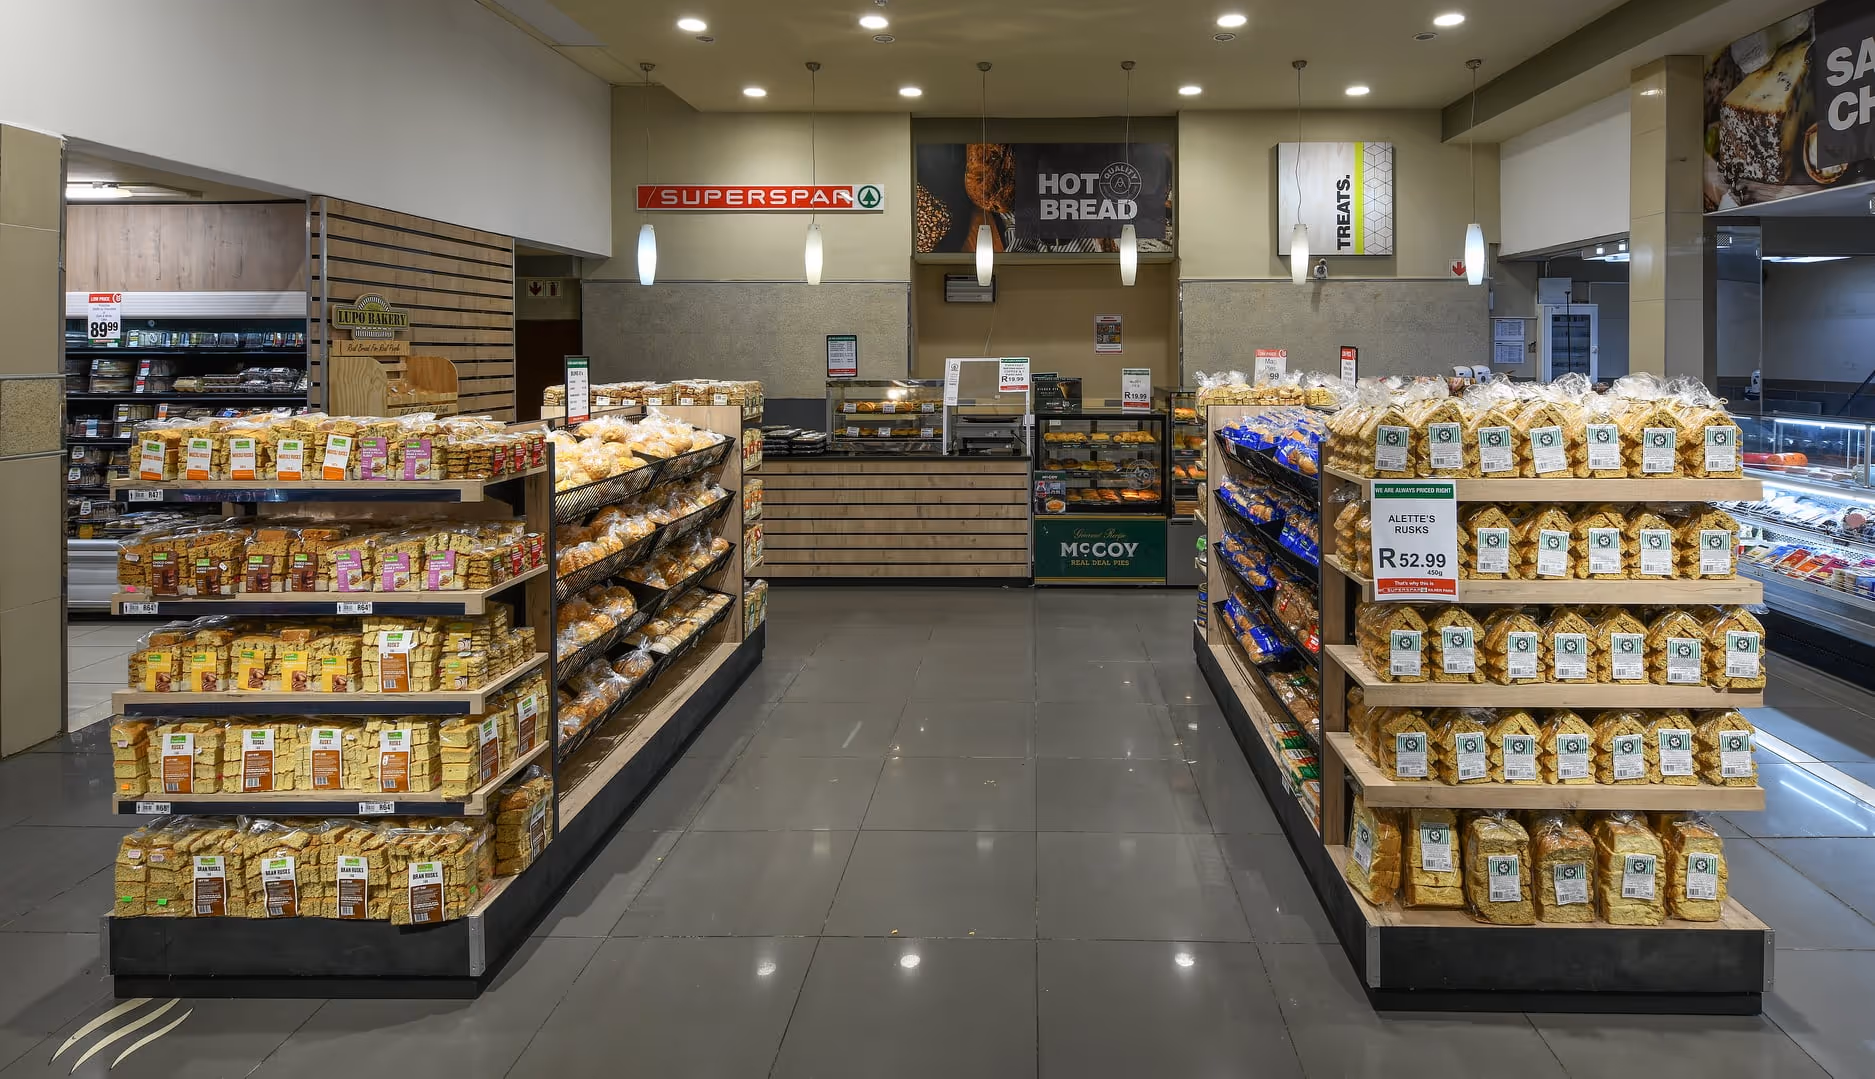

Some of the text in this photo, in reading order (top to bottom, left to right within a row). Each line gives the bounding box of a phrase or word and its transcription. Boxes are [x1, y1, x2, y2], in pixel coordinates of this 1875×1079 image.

[1103, 165, 1139, 181] QUALITY
[1038, 173, 1100, 195] HOT
[660, 189, 853, 206] SUPERSPAR
[1040, 199, 1138, 220] BREAD
[1337, 173, 1351, 251] TREATS.
[338, 310, 407, 326] LUPO BAKERY
[1388, 514, 1436, 523] ALETTE'S
[1394, 526, 1429, 534] RUSKS
[1060, 542, 1139, 558] McCOY
[1378, 547, 1446, 568] R 52.99
[1427, 569, 1443, 577] 450g
